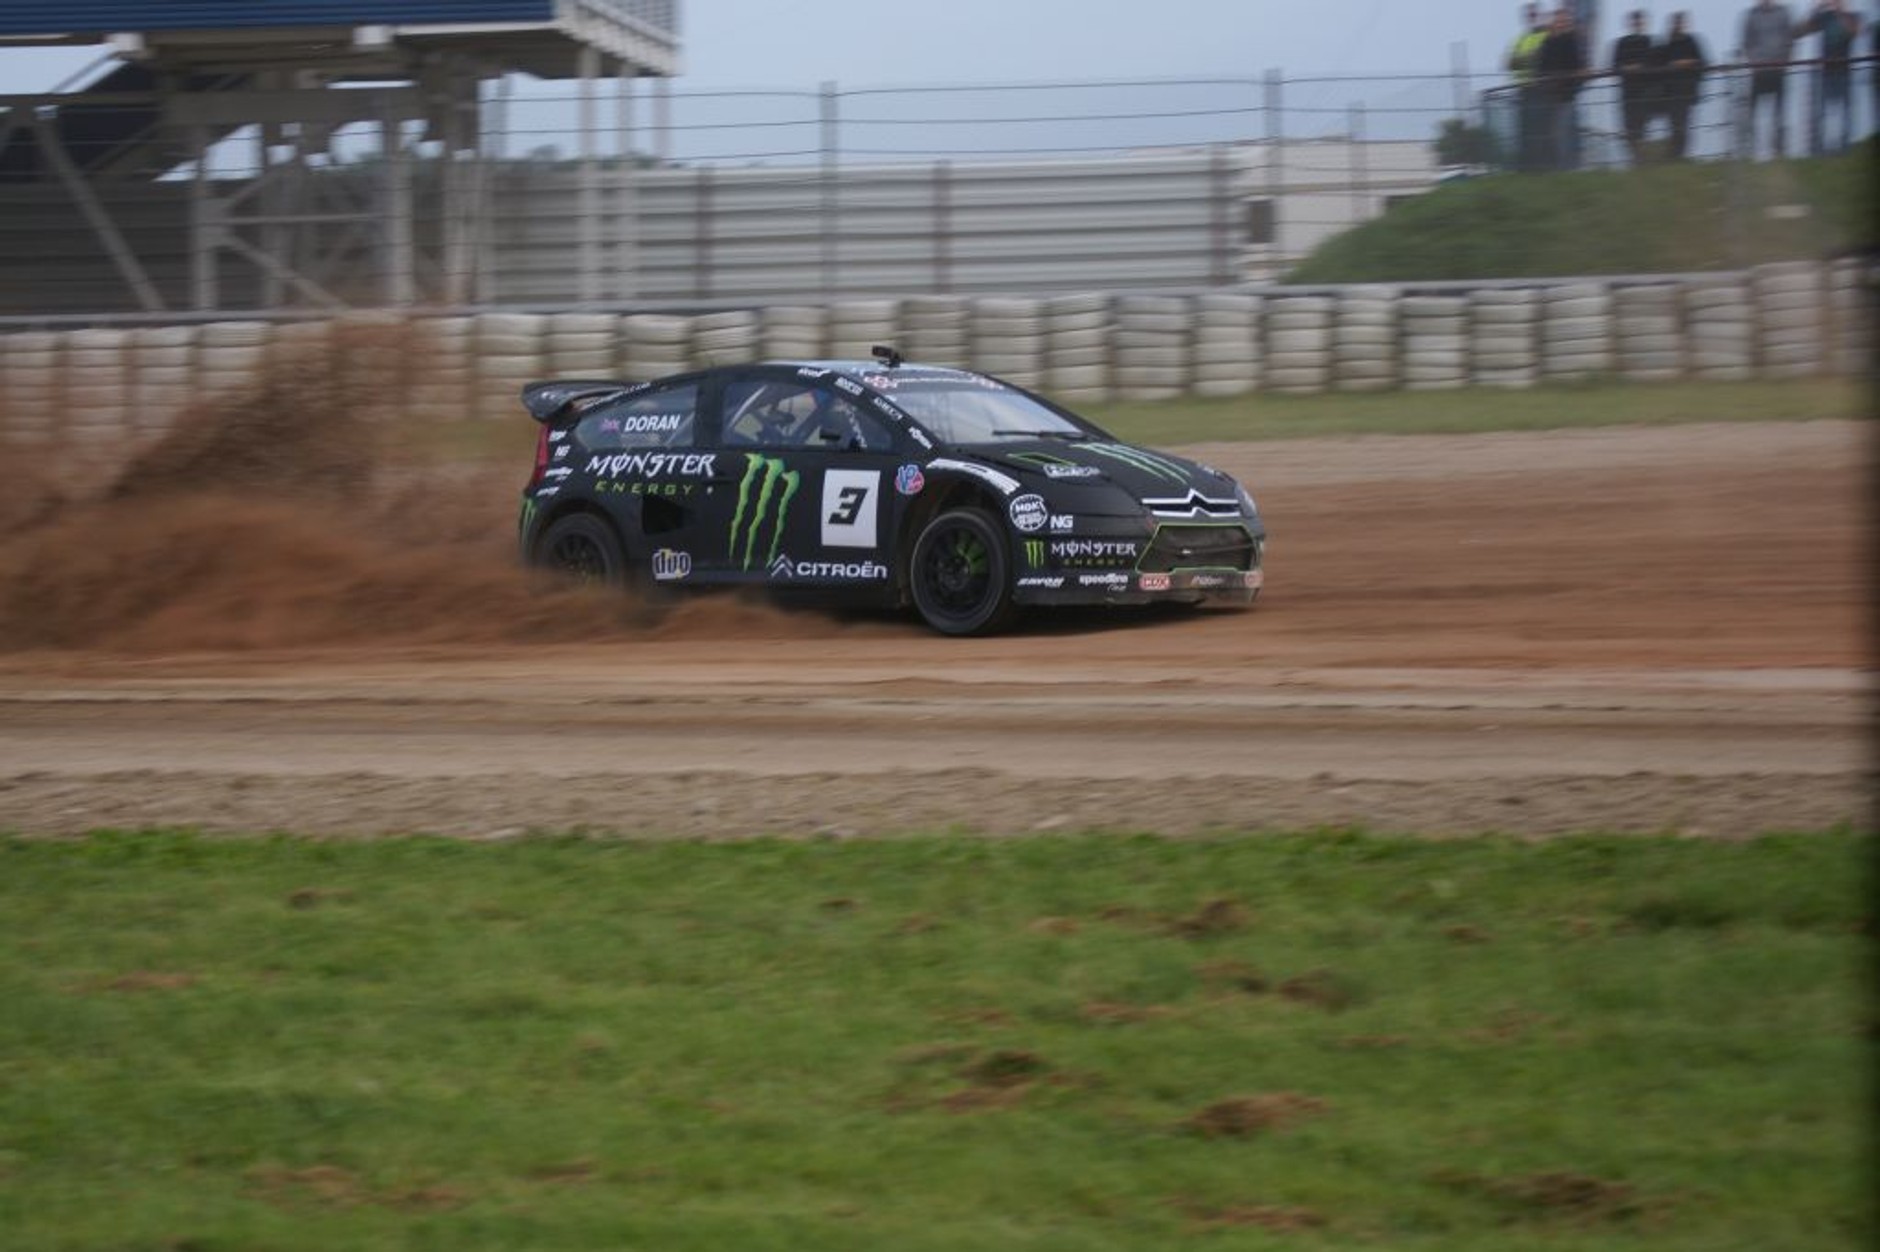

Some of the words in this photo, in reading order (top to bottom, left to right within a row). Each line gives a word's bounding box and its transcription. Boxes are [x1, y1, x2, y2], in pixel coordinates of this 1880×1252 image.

[624, 414, 681, 433] DORAN
[594, 480, 693, 496] ENERGY
[828, 486, 870, 526] 3
[1050, 515, 1074, 529] NG
[1050, 540, 1137, 557] MONSTER
